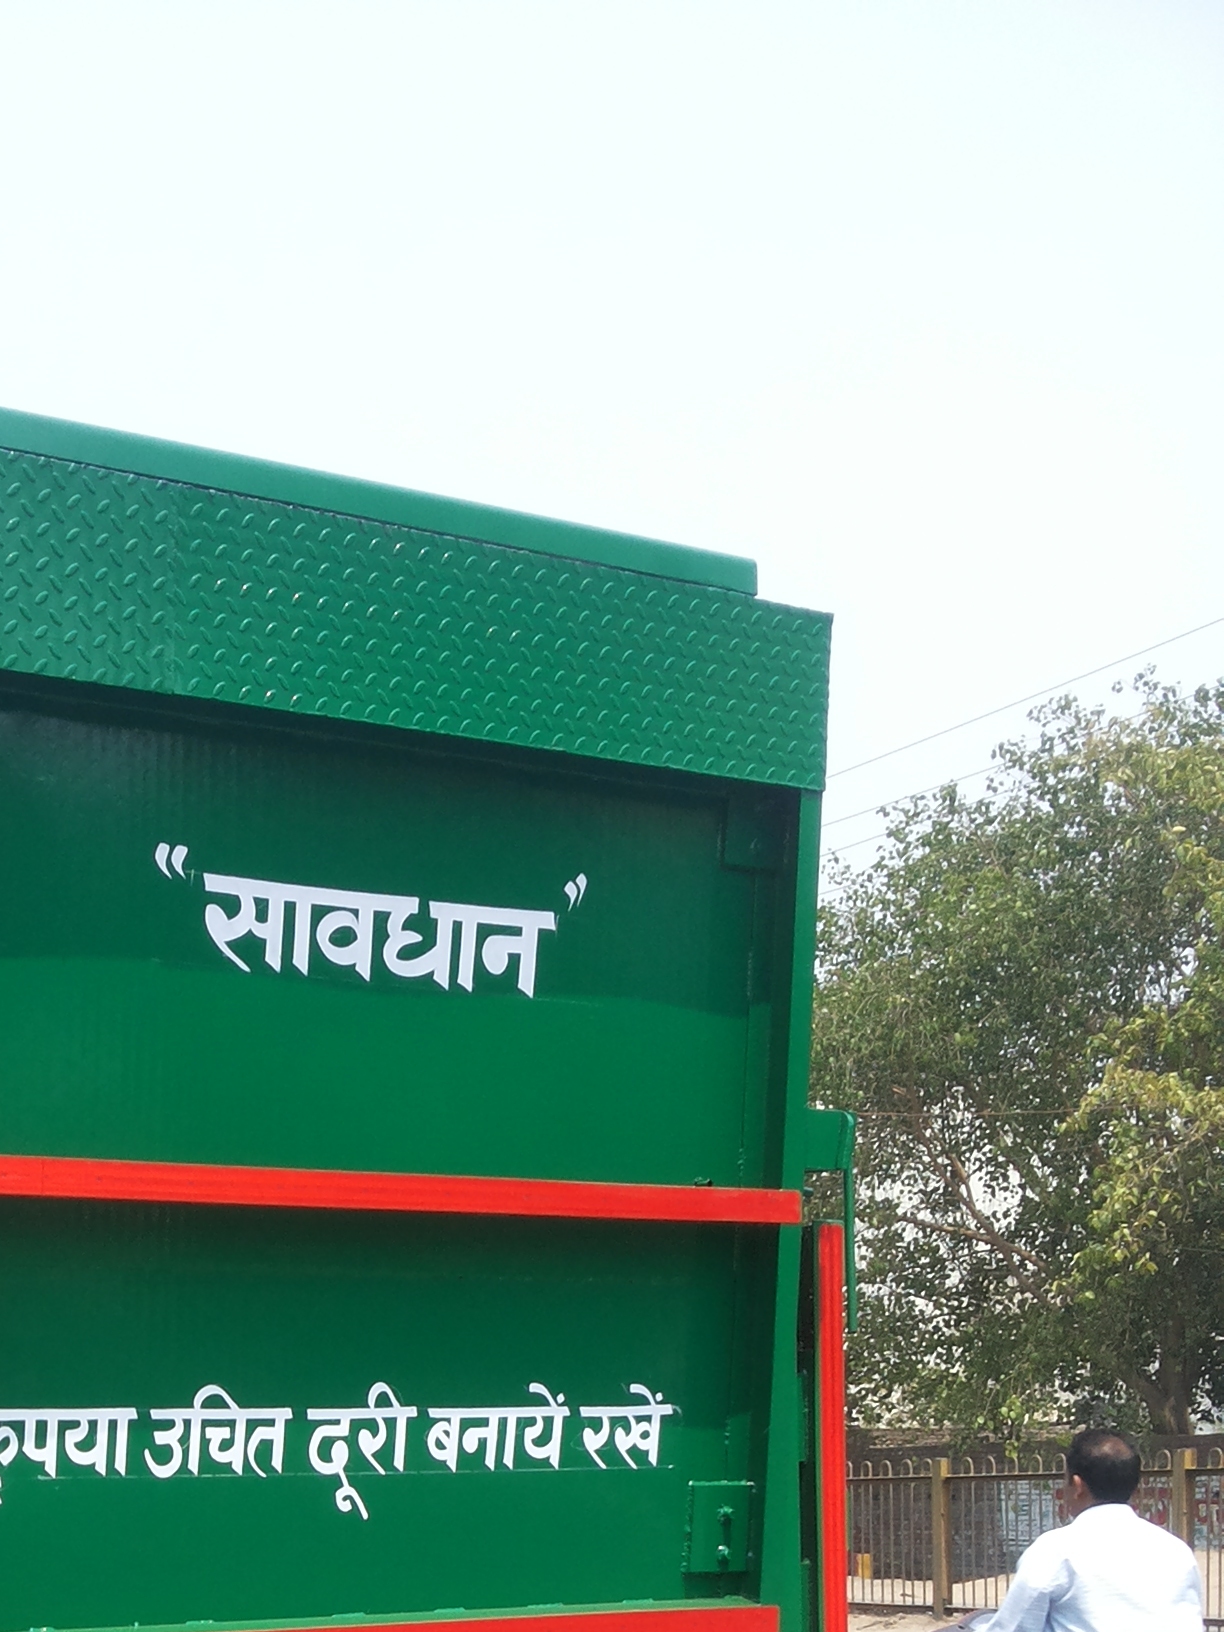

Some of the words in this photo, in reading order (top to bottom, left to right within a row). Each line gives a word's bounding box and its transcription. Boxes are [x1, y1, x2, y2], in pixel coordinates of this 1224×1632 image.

[144, 1384, 293, 1478] उचित
[307, 1382, 417, 1519] दूरी
[427, 1383, 570, 1472] बनायें
[580, 1384, 674, 1469] रखें
